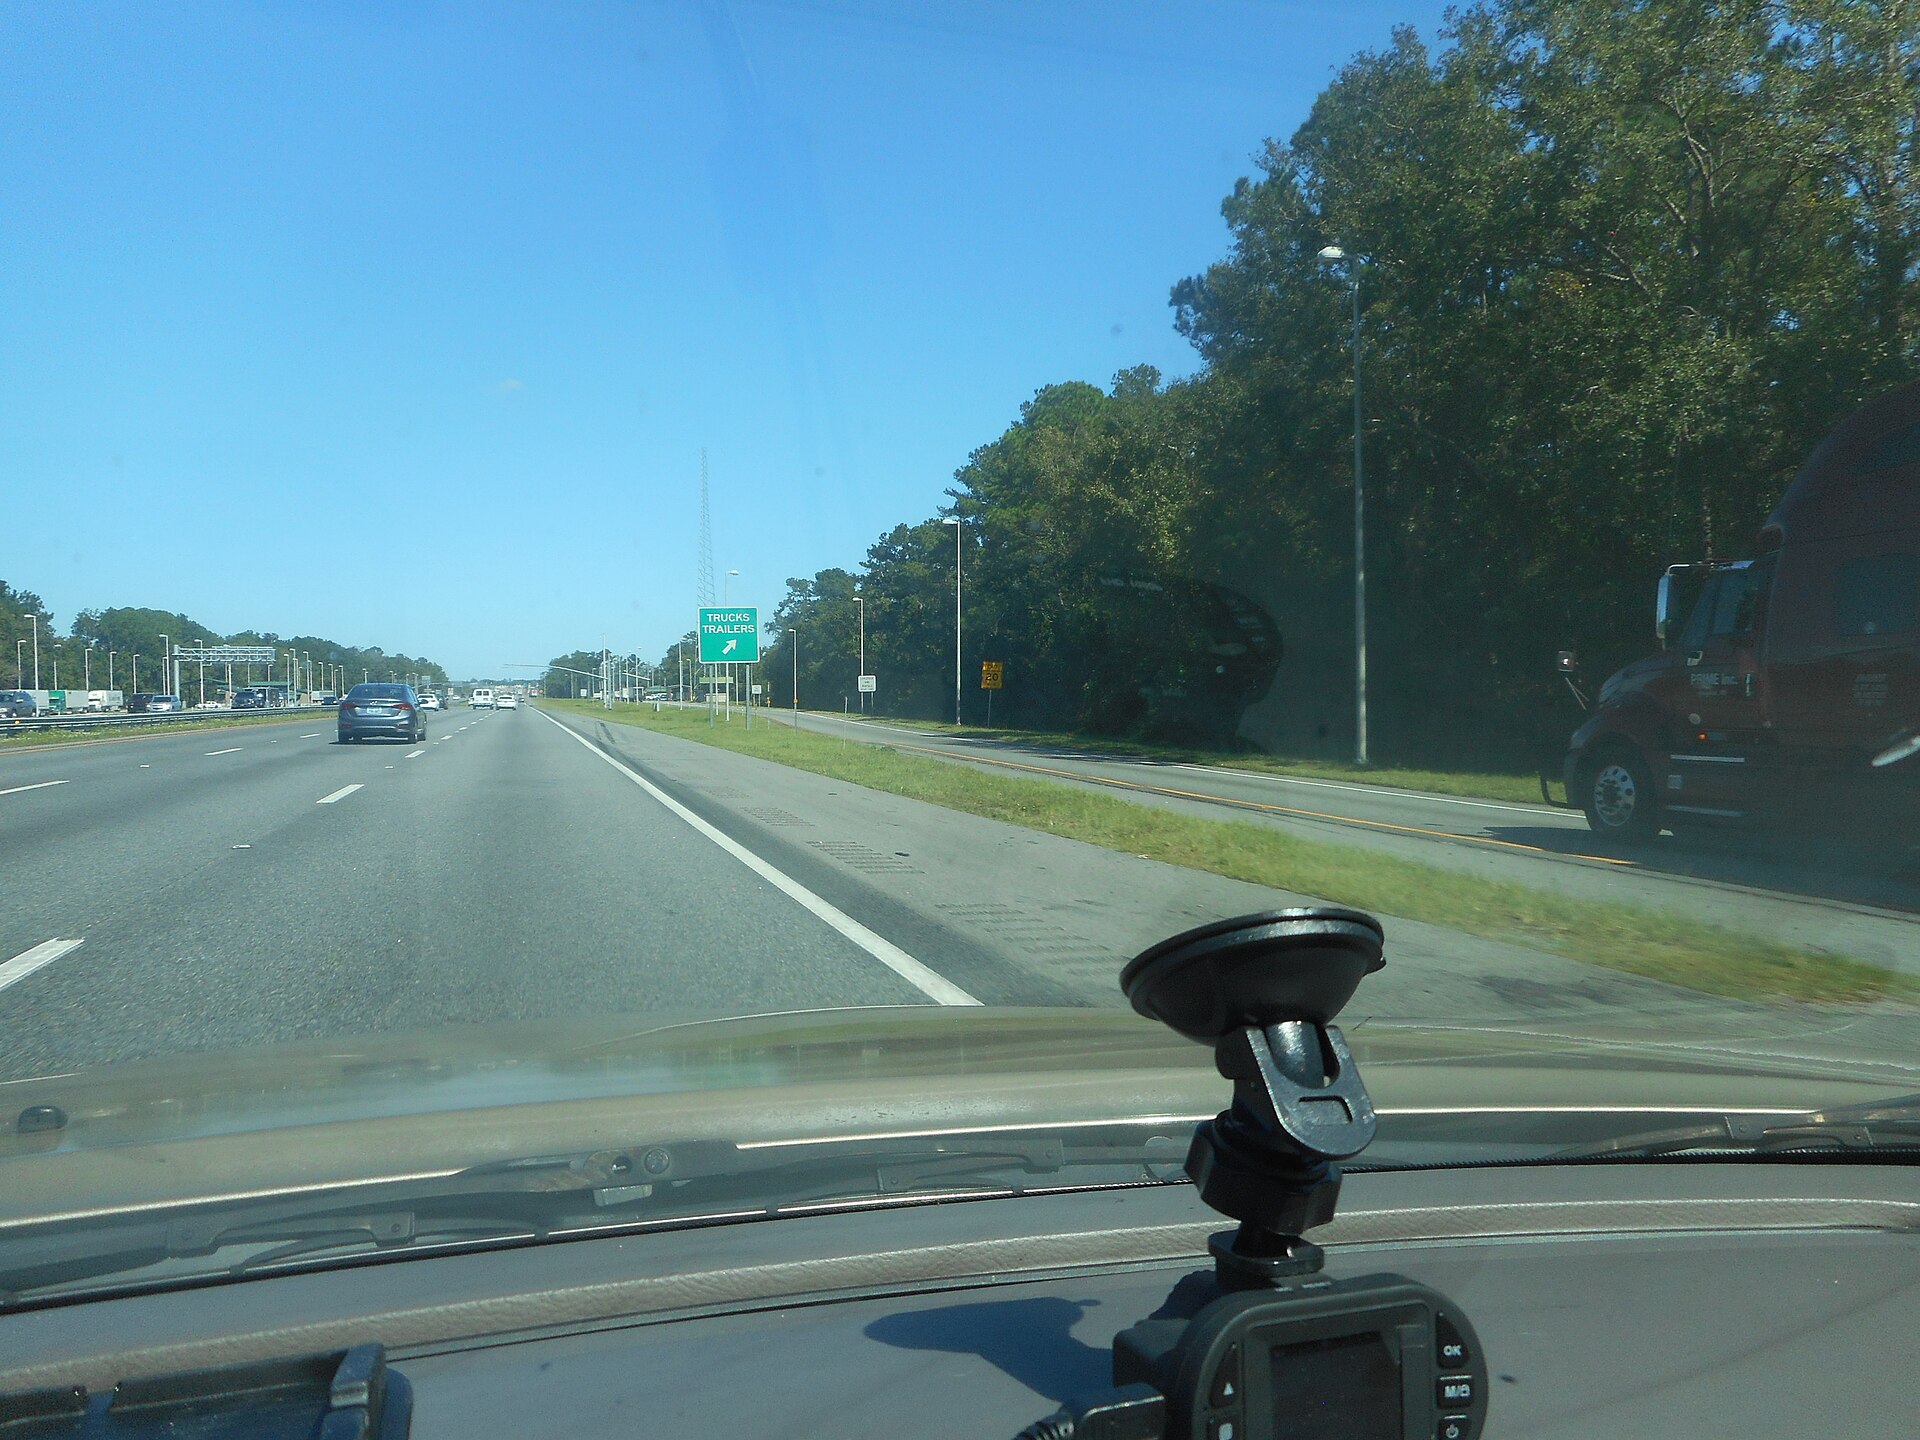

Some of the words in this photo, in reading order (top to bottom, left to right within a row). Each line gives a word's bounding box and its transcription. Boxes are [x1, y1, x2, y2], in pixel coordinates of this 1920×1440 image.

[707, 613, 750, 622] TRUCKS
[702, 625, 755, 633] TRAILERS
[986, 672, 999, 682] 20
[1690, 673, 1719, 685] PRIME
[1443, 1345, 1462, 1356] OK
